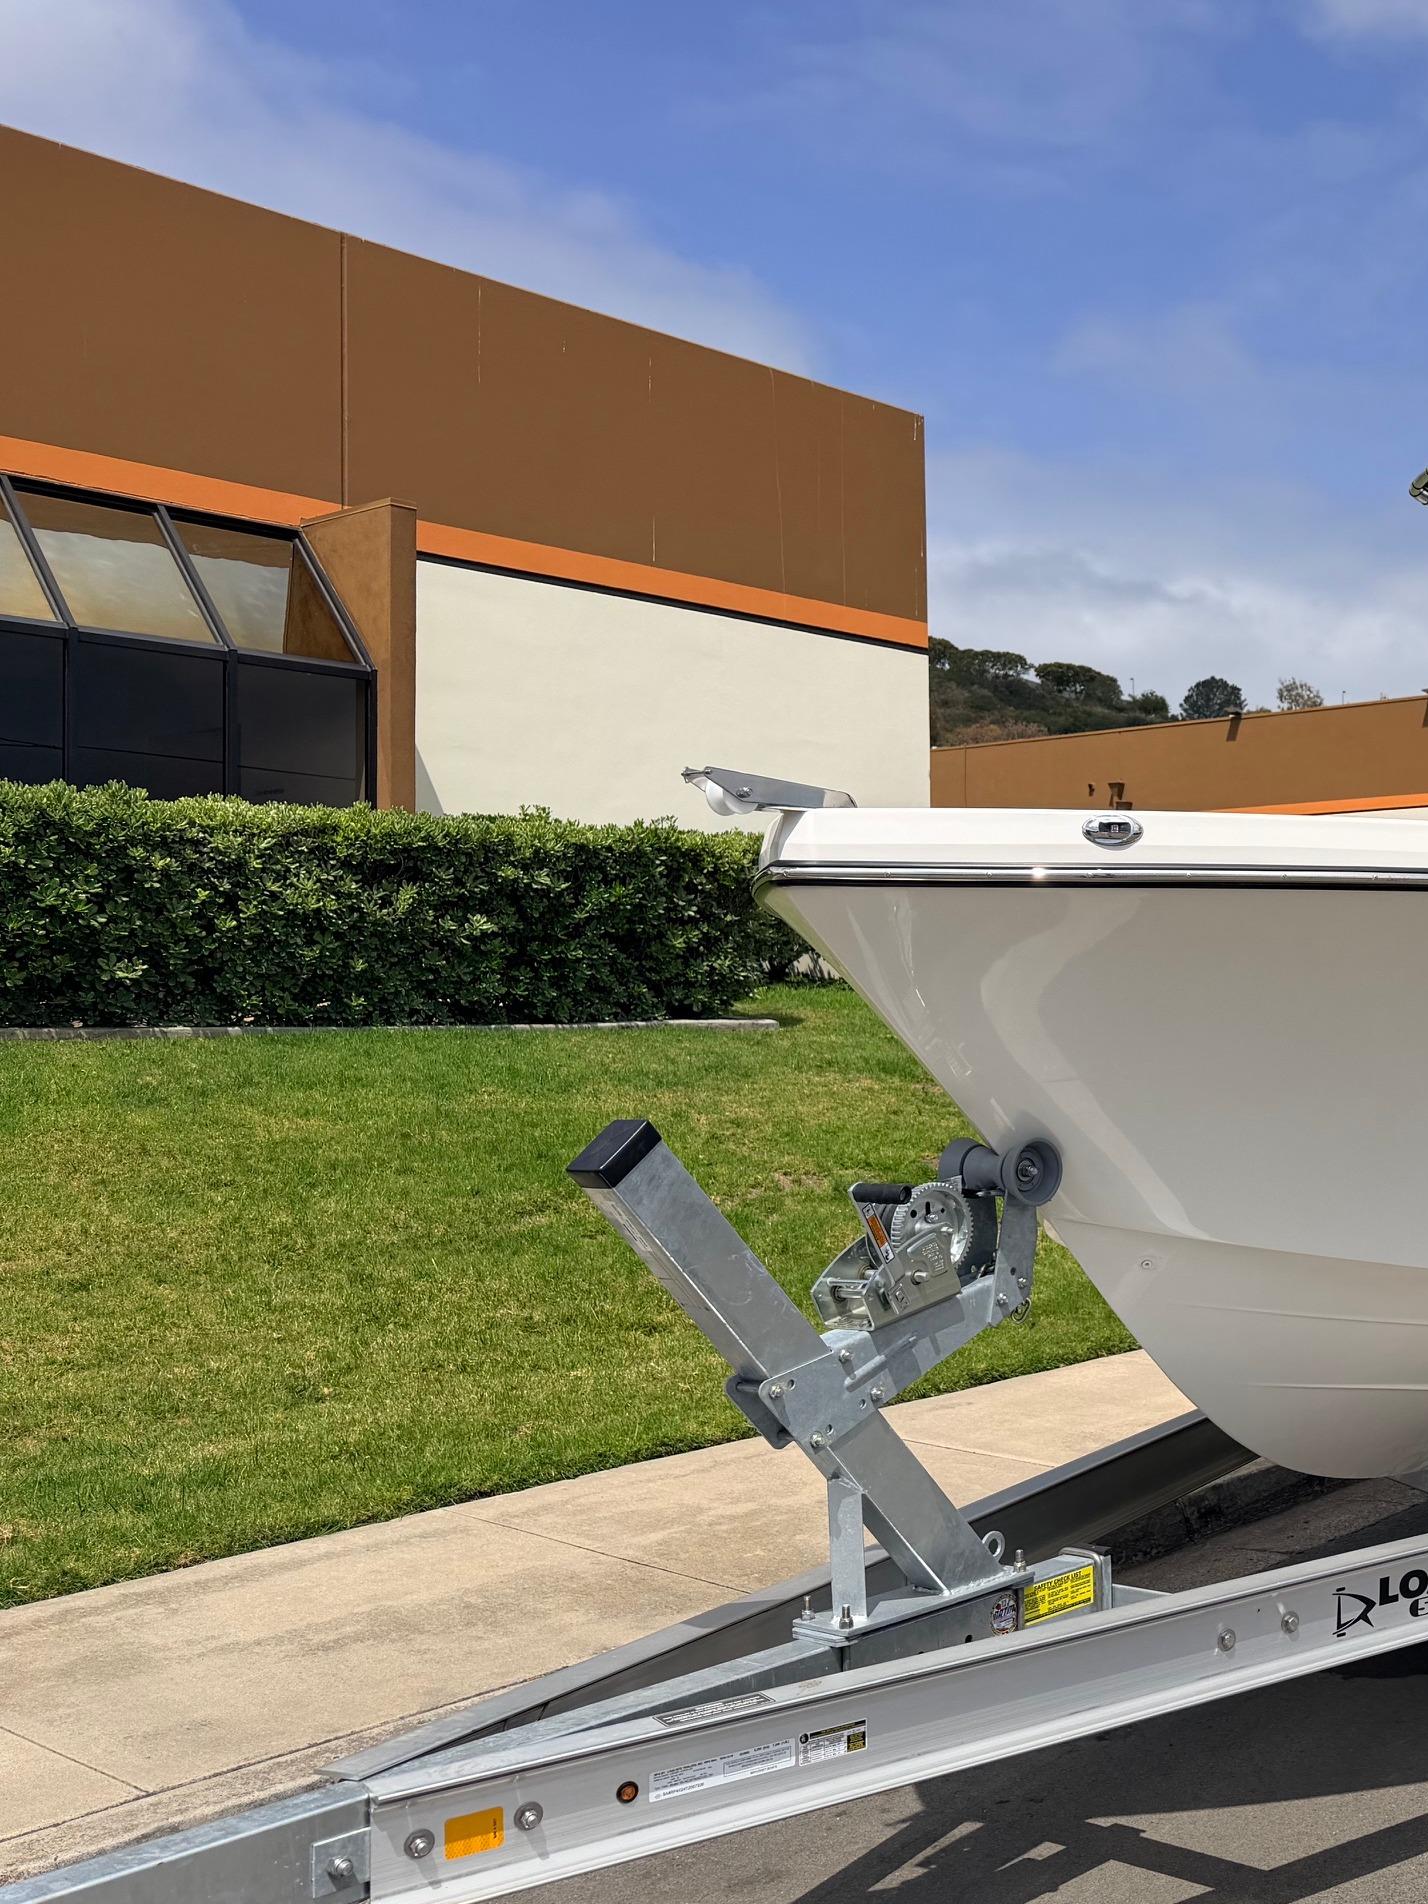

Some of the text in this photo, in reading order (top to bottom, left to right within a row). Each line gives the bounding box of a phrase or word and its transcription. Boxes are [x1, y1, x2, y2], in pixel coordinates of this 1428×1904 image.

[1034, 1571, 1082, 1590] SAFETY CHECK LIST
